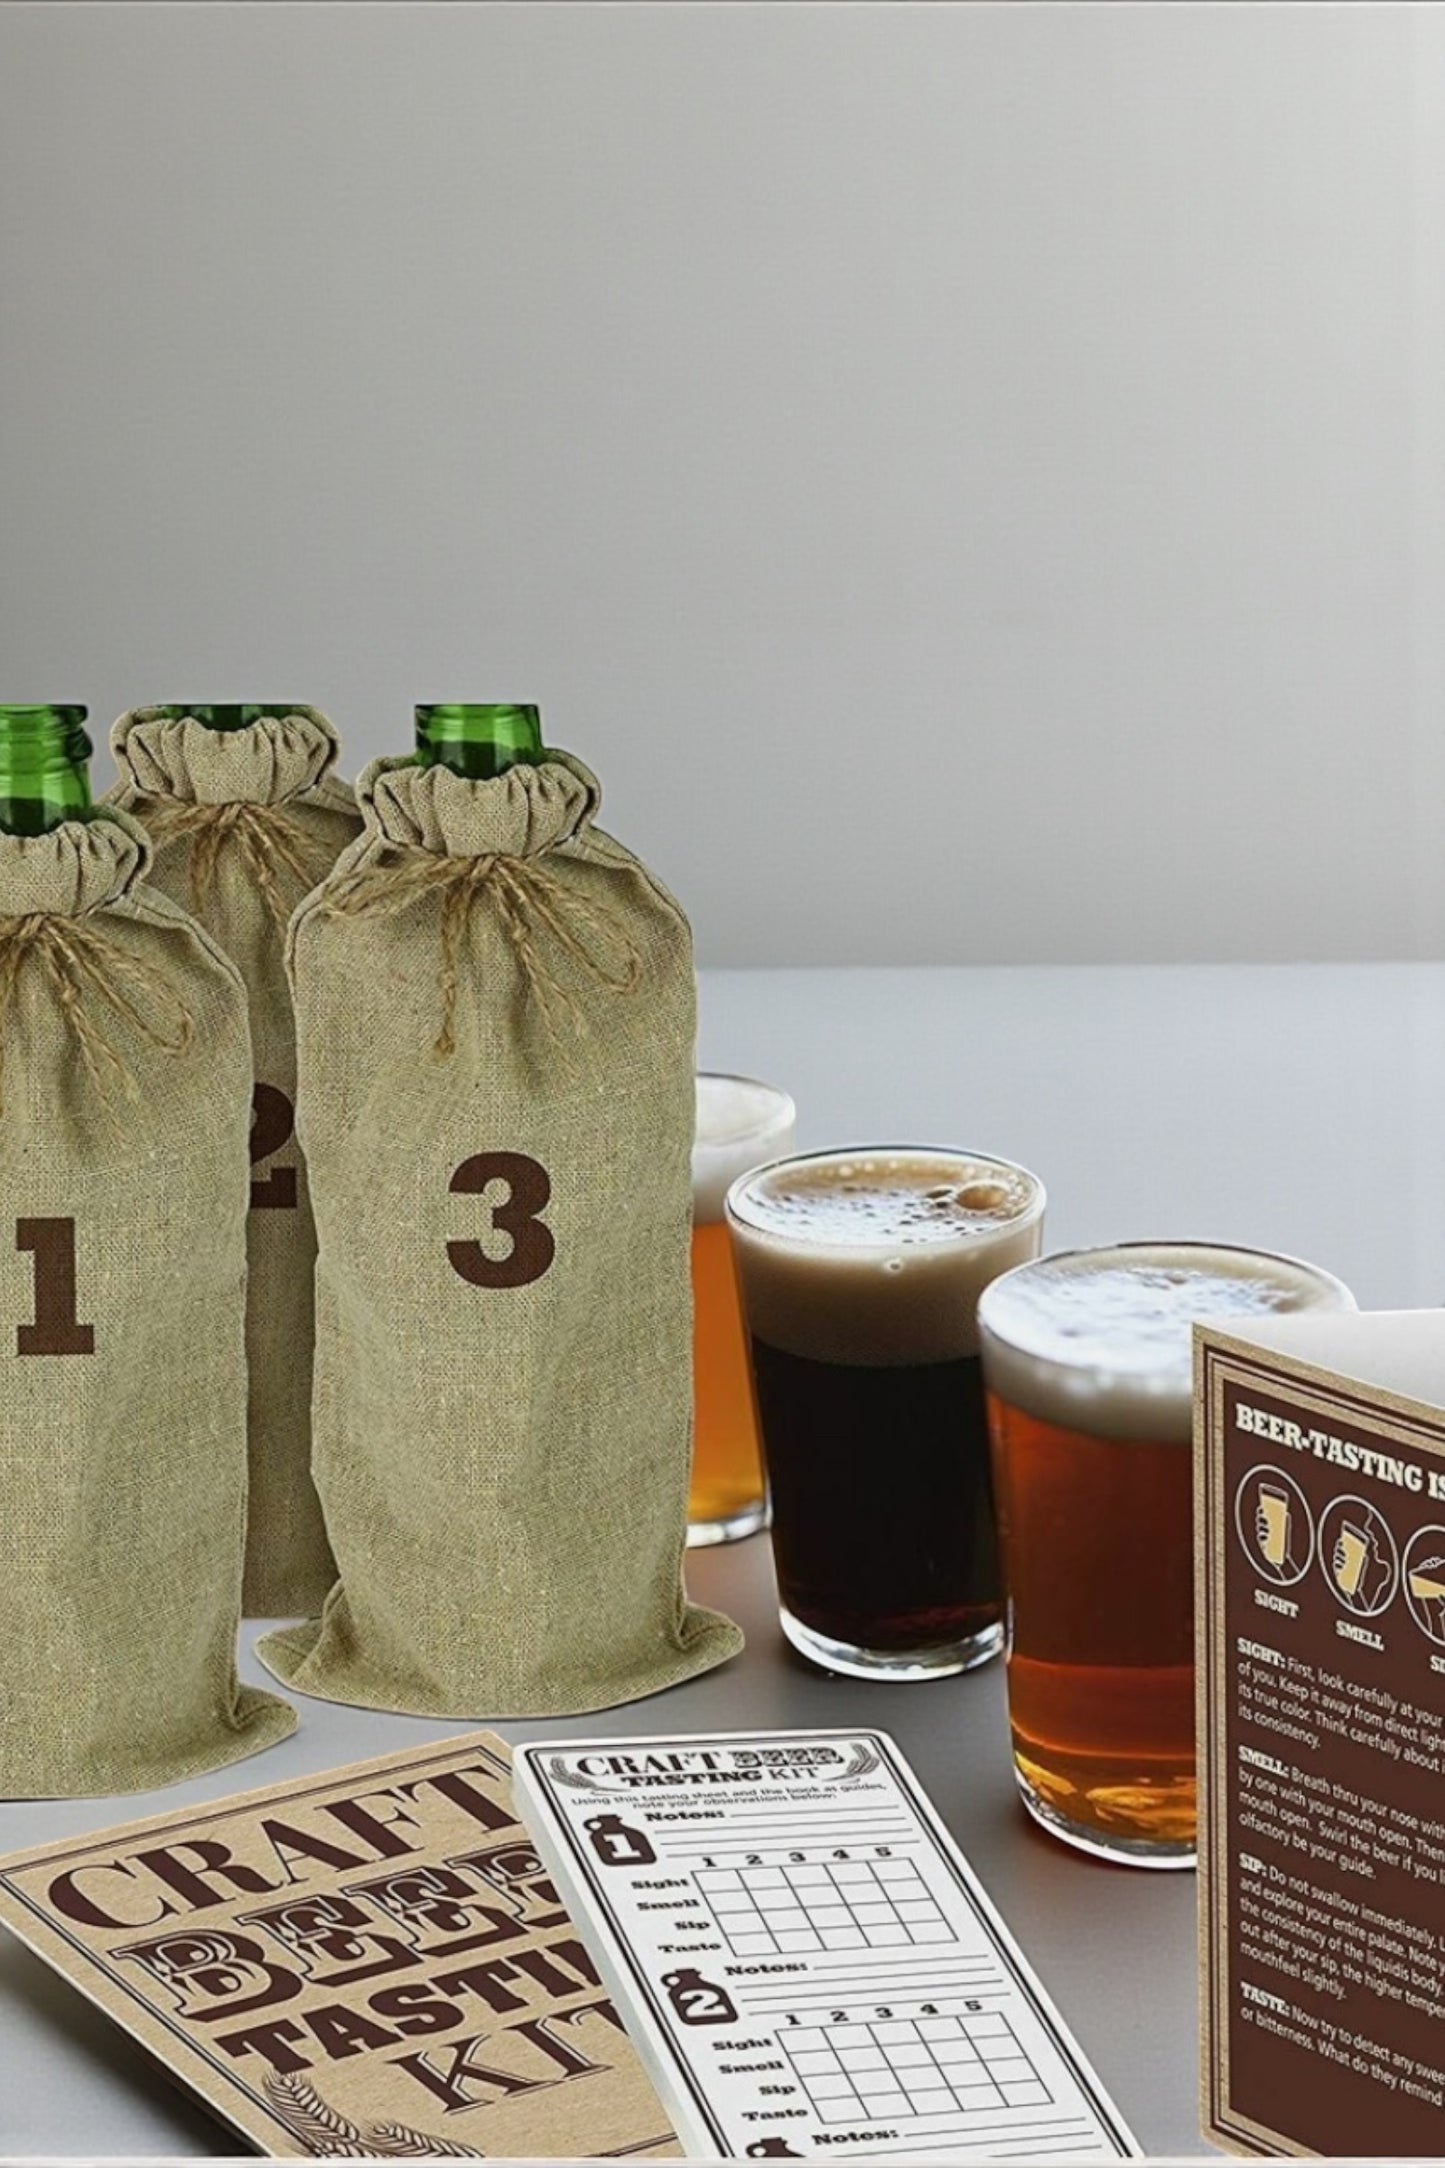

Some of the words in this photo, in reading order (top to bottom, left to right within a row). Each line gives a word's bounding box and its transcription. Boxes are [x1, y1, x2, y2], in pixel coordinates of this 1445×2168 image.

[446, 1151, 556, 1289] 3
[16, 1217, 95, 1355] 1
[1236, 1403, 1423, 1492] BEER-TASTING
[1254, 1588, 1299, 1618] SIGHT
[1336, 1619, 1384, 1651] SMELL
[1237, 1637, 1286, 1669] SIGHT:
[1287, 1657, 1315, 1682] First,
[1318, 1667, 1344, 1692] look
[1346, 1682, 1398, 1715] carefully
[1400, 1702, 1413, 1718] at
[1414, 1708, 1443, 1728] your
[1237, 1661, 1251, 1676] of
[1252, 1668, 1277, 1689] you.
[1279, 1675, 1309, 1702] Keep
[1310, 1686, 1319, 1702] it
[1322, 1694, 1353, 1719] away
[1354, 1703, 1382, 1729] from
[1384, 1717, 1418, 1742] direct
[1238, 1701, 1252, 1720] its
[1254, 1710, 1320, 1749] consistency.
[1238, 1680, 1252, 1699] its
[1254, 1688, 1278, 1710] true
[1280, 1701, 1311, 1722] color.
[1314, 1710, 1348, 1737] Think
[1350, 1726, 1400, 1760] carefully
[1403, 1747, 1440, 1772] about
[577, 1752, 721, 1777] CRAFT
[728, 1747, 845, 1769] BEER
[620, 1770, 763, 1788] TASTING
[768, 1767, 820, 1780] KIT
[571, 1795, 611, 1807] Using
[614, 1793, 638, 1804] this
[642, 1791, 690, 1803] tasting
[692, 1789, 728, 1799] sheet
[732, 1787, 757, 1797] and
[761, 1786, 783, 1796] the
[786, 1784, 820, 1794] book
[840, 1781, 887, 1793] guides,
[633, 1800, 664, 1809] note
[668, 1799, 699, 1809] your
[703, 1794, 788, 1805] observations
[1238, 1745, 1289, 1778] SMELL:
[1291, 1766, 1330, 1795] Breath
[1332, 1784, 1358, 1806] thru
[1360, 1796, 1388, 1817] your
[1390, 1809, 1418, 1830] nose
[645, 1810, 725, 1822] Notes:
[1238, 1765, 1253, 1788] by
[1254, 1775, 1278, 1796] one
[1279, 1785, 1306, 1807] with
[1307, 1797, 1335, 1818] your
[1336, 1809, 1377, 1835] mouth
[1378, 1826, 1413, 1850] open.
[48, 1764, 522, 1930] CRAFT
[603, 1833, 642, 1859] 1
[1238, 1791, 1277, 1818] mouth
[1279, 1807, 1312, 1831] open.
[1318, 1820, 1348, 1846] Swirl
[1350, 1834, 1370, 1855] the
[1372, 1842, 1400, 1866] beer
[1402, 1853, 1412, 1871] if
[1413, 1862, 1437, 1882] you
[1238, 1811, 1291, 1847] olfactory
[1292, 1830, 1307, 1851] be
[1309, 1841, 1336, 1863] your
[1338, 1854, 1376, 1879] guide.
[702, 1856, 717, 1868] 1
[744, 1854, 763, 1866] 2
[788, 1851, 806, 1863] 3
[832, 1849, 850, 1860] 4
[874, 1846, 892, 1857] 5
[631, 1878, 690, 1890] Sight
[636, 1899, 701, 1911] Smell
[1239, 1852, 1267, 1877] SIP:
[1268, 1865, 1286, 1885] Do
[1288, 1876, 1309, 1896] not
[1310, 1886, 1359, 1916] swallow
[1361, 1903, 1436, 1950] immediately.
[674, 1920, 710, 1931] Sip
[1239, 1877, 1261, 1897] and
[1263, 1887, 1304, 1916] explore
[1305, 1905, 1332, 1926] your
[1332, 1917, 1367, 1942] entire
[1368, 1931, 1407, 1959] palate.
[1409, 1945, 1437, 1971] Note
[1240, 1896, 1259, 1917] the
[1262, 1907, 1326, 1949] consistency
[1328, 1935, 1342, 1951] of
[1344, 1942, 1364, 1962] the
[657, 1942, 722, 1954] Taste
[1240, 1920, 1260, 1939] out
[1262, 1929, 1290, 1951] after
[1291, 1942, 1319, 1964] your
[1342, 1963, 1363, 1984] the
[1364, 1970, 1402, 2000] higher
[724, 1961, 808, 1977] Notes:
[1240, 1941, 1300, 1978] mouthfeel
[1302, 1968, 1347, 2000] slightly.
[679, 1988, 729, 2018] 2
[785, 2013, 803, 2026] 1
[830, 2010, 850, 2023] 2
[875, 2007, 894, 2020] 3
[920, 2003, 939, 2016] 4
[964, 2000, 983, 2012] 5
[1240, 1980, 1290, 2016] TASTE:
[1291, 2005, 1319, 2030] Now
[1320, 2020, 1337, 2041] try
[1339, 2028, 1352, 2044] to
[1353, 2034, 1390, 2063] detect
[1392, 2052, 1414, 2075] any
[712, 2036, 773, 2052] Sight
[1240, 2007, 1253, 2022] or
[1256, 2008, 1315, 2050] bitterness.
[1317, 2038, 1350, 2067] What
[1352, 2055, 1369, 2074] do
[1370, 2064, 1398, 2090] they
[1400, 2078, 1443, 2107] remind
[718, 2059, 785, 2075] Smell
[758, 2083, 797, 2097] Sip
[741, 2106, 809, 2122] Taste
[811, 2128, 899, 2146] Notes:
